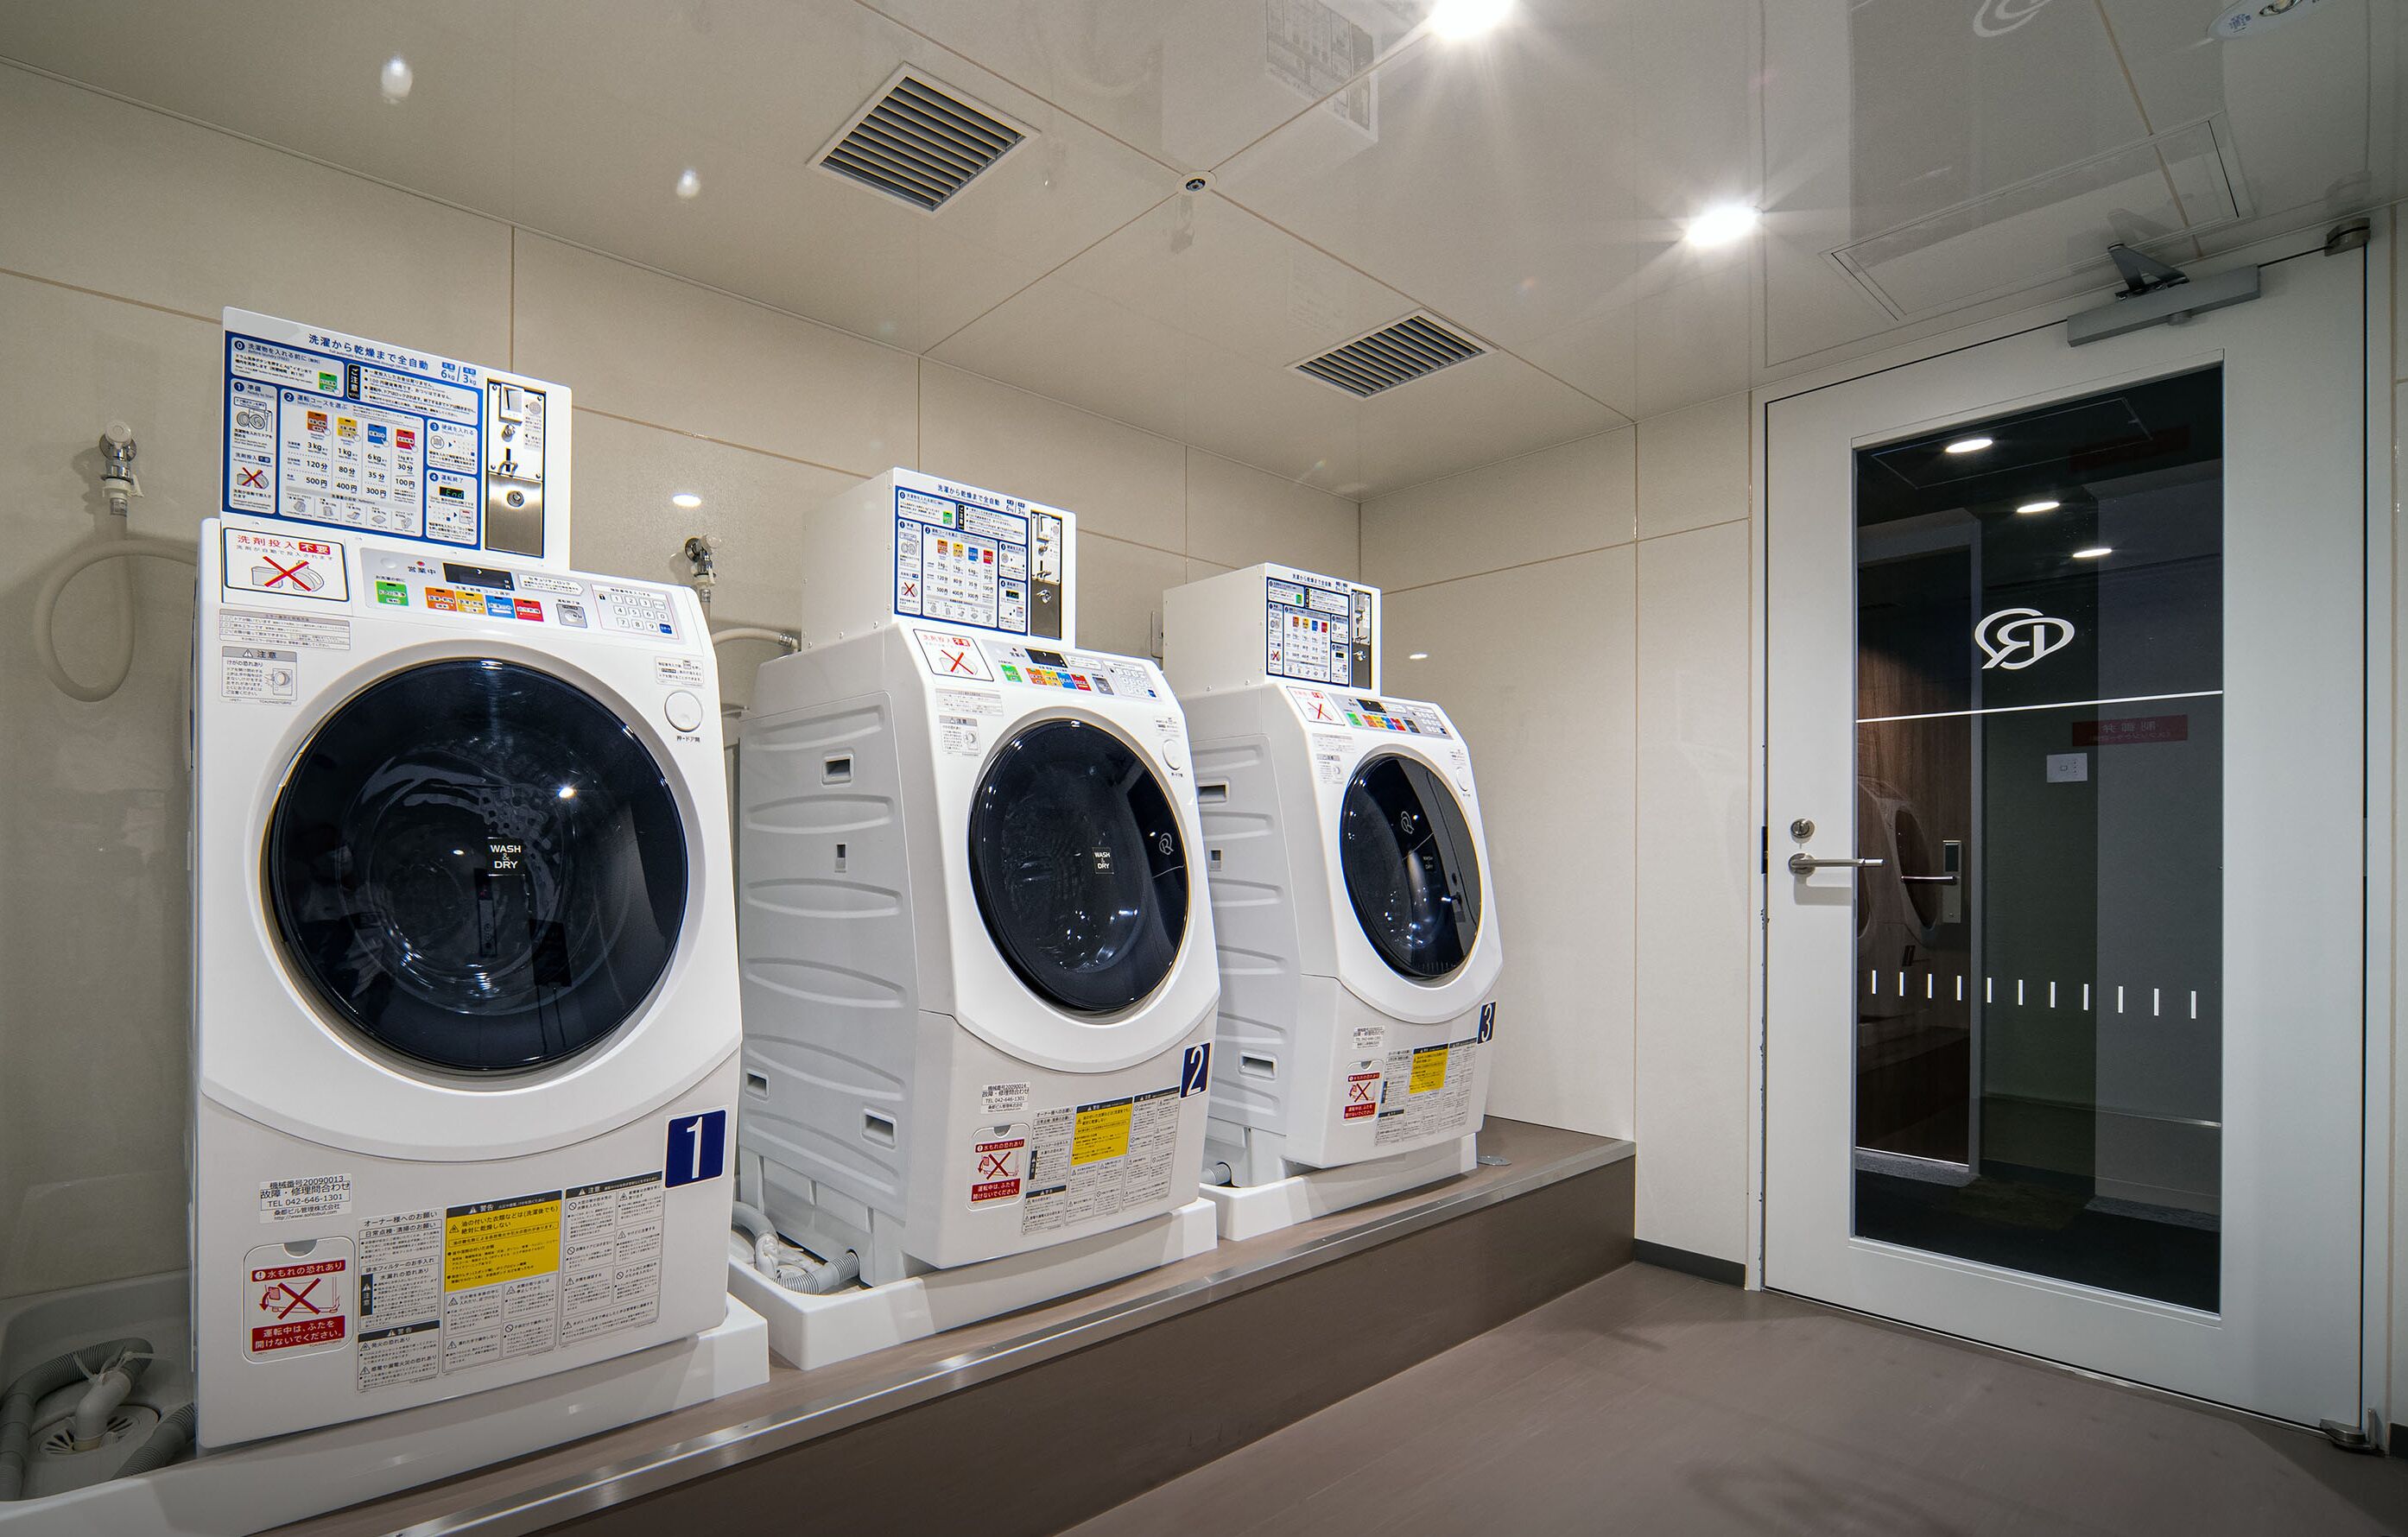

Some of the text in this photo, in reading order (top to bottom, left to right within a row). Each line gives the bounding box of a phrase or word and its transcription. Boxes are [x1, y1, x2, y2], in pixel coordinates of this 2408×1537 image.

[248, 343, 307, 361] 洗濯物を入れる前に
[309, 334, 428, 370] 洗濯から乾燥まで全自動
[297, 394, 348, 410] 運転コースを選ぶ
[307, 460, 414, 480] 120分 80分 35分 30分
[306, 477, 415, 497] 500円 400円 300円 100円
[937, 484, 1001, 506] 洗濯から乾燥まで全自動
[237, 534, 329, 554] 洗剤投入 不要
[237, 544, 333, 560] 洗剤が自動で投入されます
[408, 566, 437, 575] 営業中
[257, 649, 277, 659] 注意
[490, 844, 522, 853] WASH
[502, 852, 510, 861] &
[494, 860, 518, 869] DRY
[1481, 1003, 1492, 1042] 3
[1186, 1045, 1204, 1097] 2
[686, 1116, 703, 1180] 1
[983, 1141, 1023, 1151] 水もれの恐れあり
[261, 1182, 350, 1199] 故障・修理問合わせ
[269, 1175, 344, 1190] 機械番号20090013
[268, 1193, 343, 1208] TEL 042-646-1301
[480, 1204, 495, 1212] 警告
[274, 1203, 340, 1216] 桑都ビル管理株式会社
[461, 1205, 559, 1227] 油の付いた衣類などは(洗濯後でも)
[364, 1211, 438, 1228] オーナー様へのお願い
[365, 1222, 436, 1237] 日常点検・清掃のお願い
[461, 1221, 511, 1235] 絶対に乾燥しない
[267, 1262, 342, 1279] 水もれの恐れあり
[365, 1258, 435, 1274] 排水フィルターのお手入れ
[380, 1268, 429, 1281] 水漏れの恐れあり
[263, 1319, 335, 1338] 運転中は、ふたを
[255, 1331, 342, 1350] 開けないでください。
[371, 1337, 411, 1348] 発火の恐れあり
